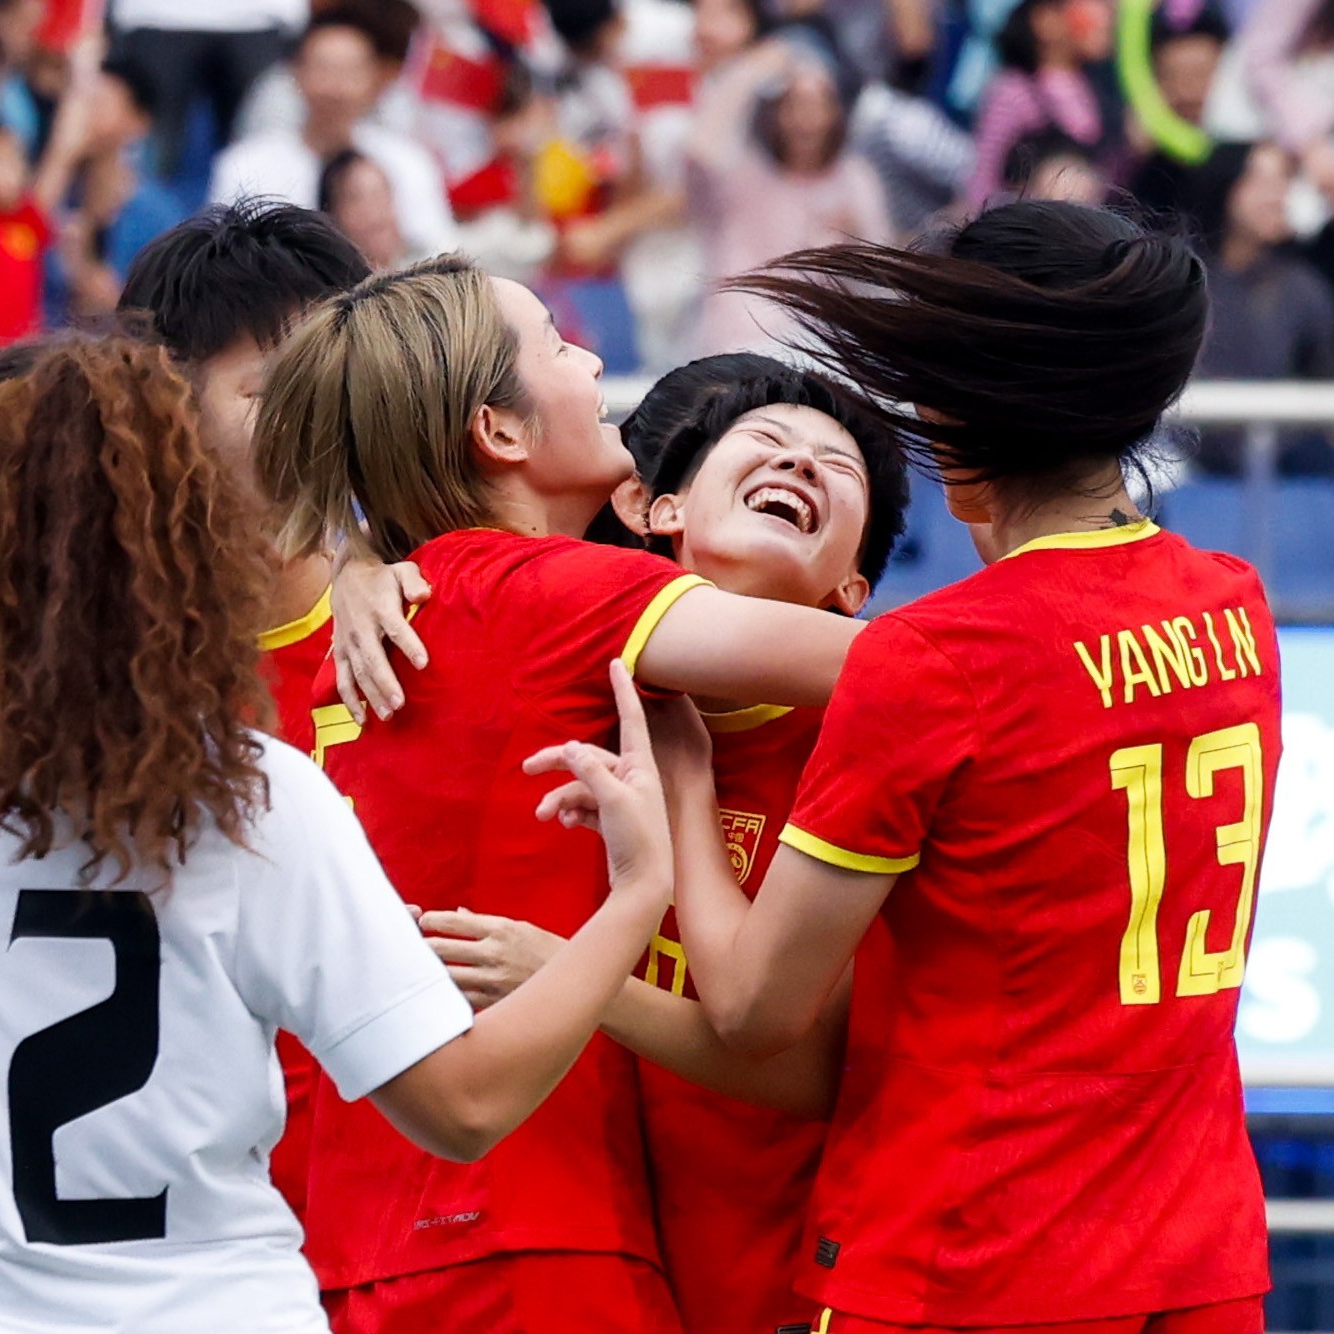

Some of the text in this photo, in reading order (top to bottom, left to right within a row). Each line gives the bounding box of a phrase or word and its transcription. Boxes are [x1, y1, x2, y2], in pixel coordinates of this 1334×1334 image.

[1072, 605, 1262, 710] YANG LN
[719, 815, 759, 835] CFA
[1110, 722, 1264, 1006] 13
